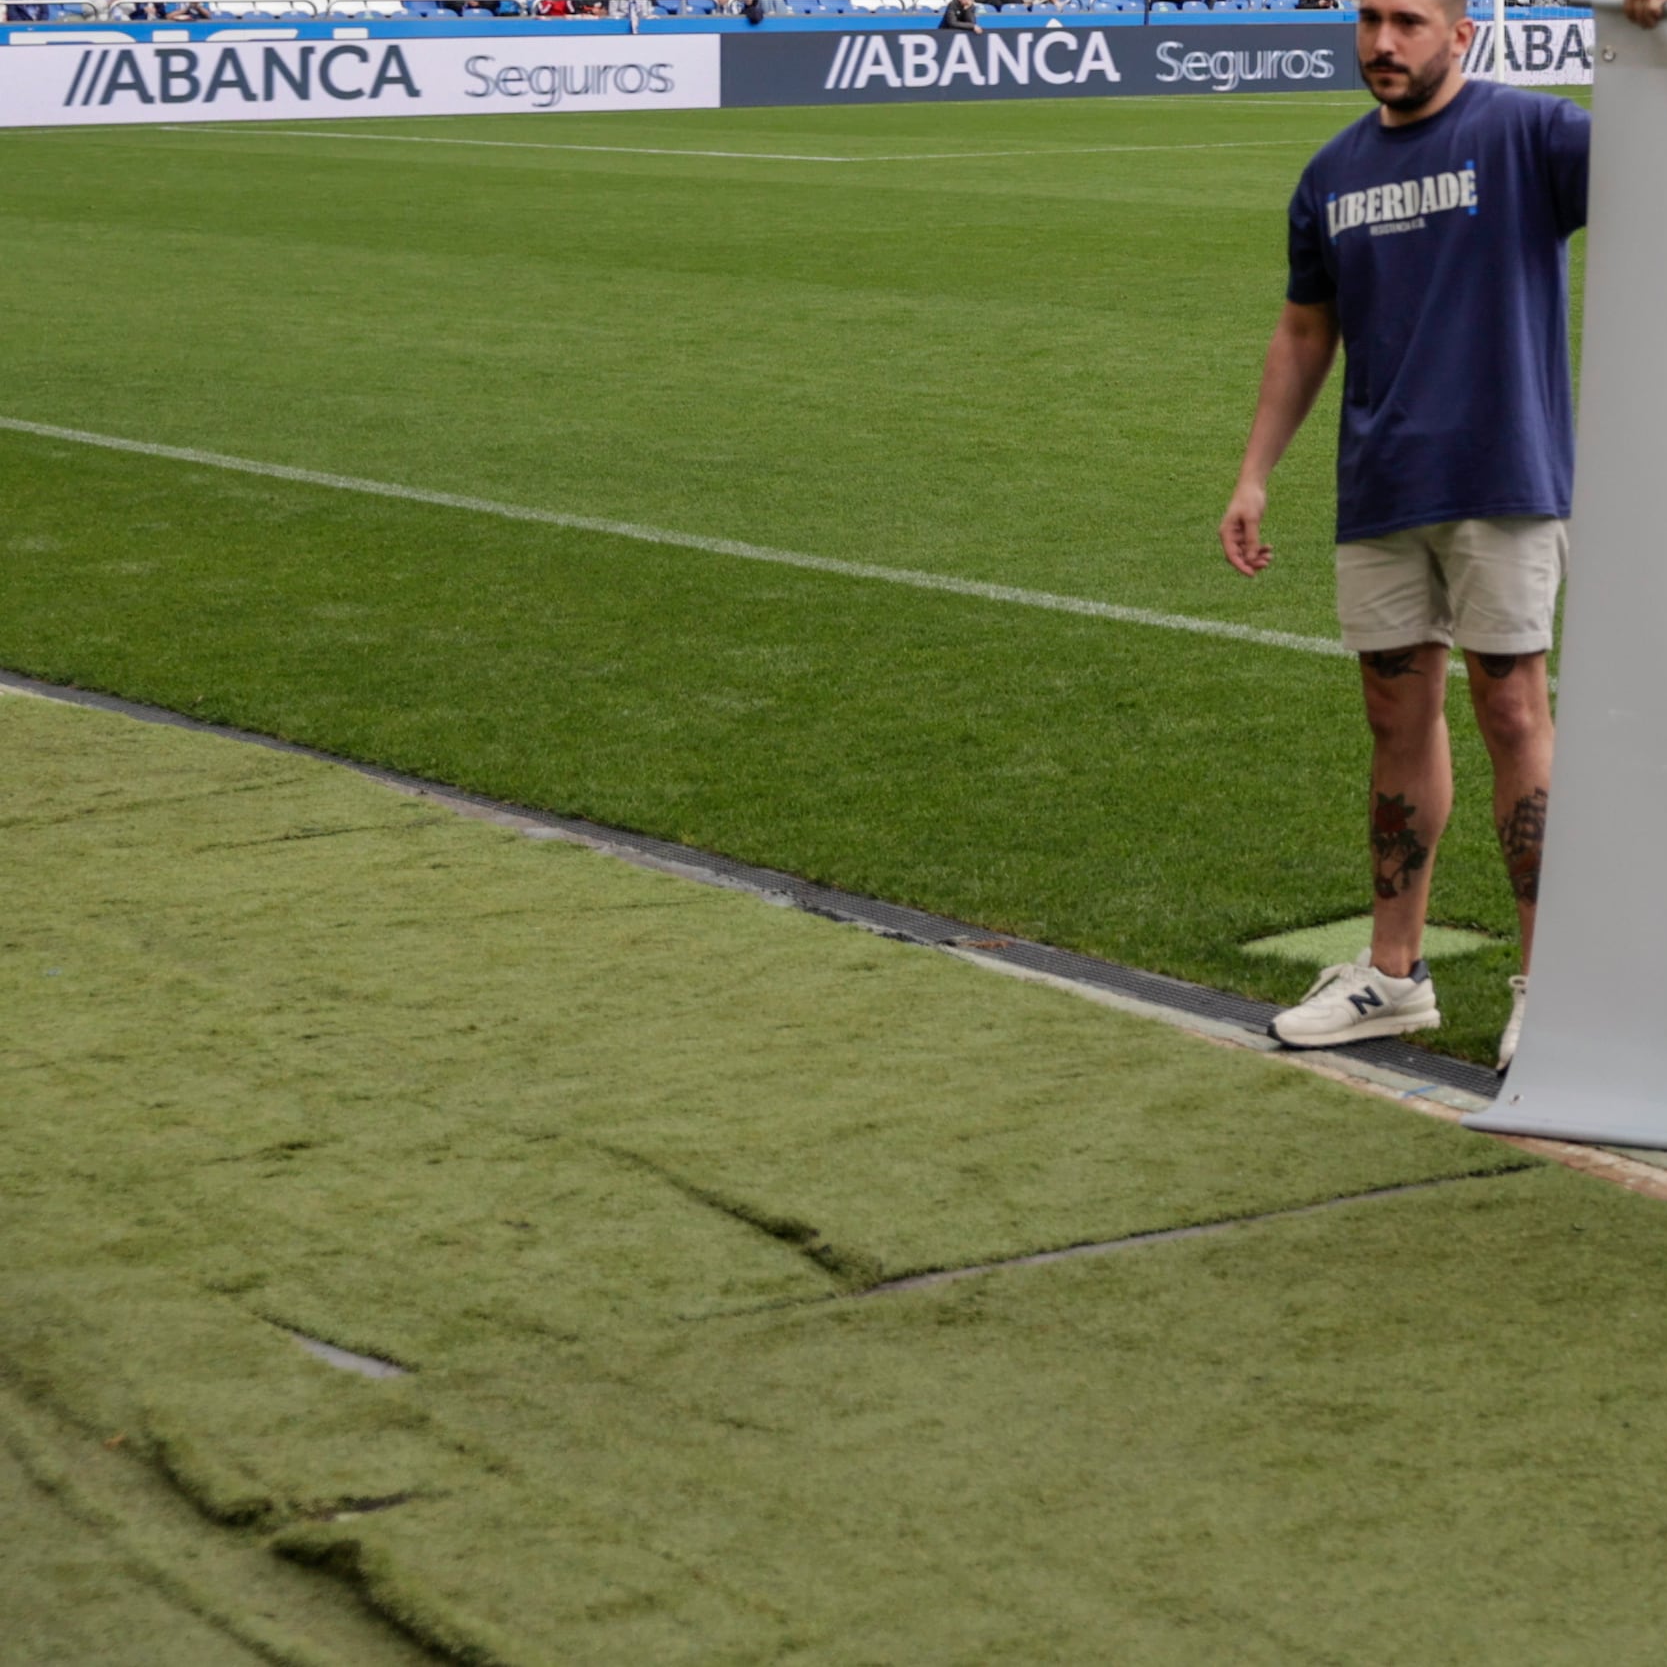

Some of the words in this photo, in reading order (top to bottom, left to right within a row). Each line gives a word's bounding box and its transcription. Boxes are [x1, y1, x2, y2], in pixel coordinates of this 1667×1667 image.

[464, 54, 675, 108] Seguros
[1156, 40, 1335, 91] Seguros
[1327, 169, 1478, 238] LIBERDADE
